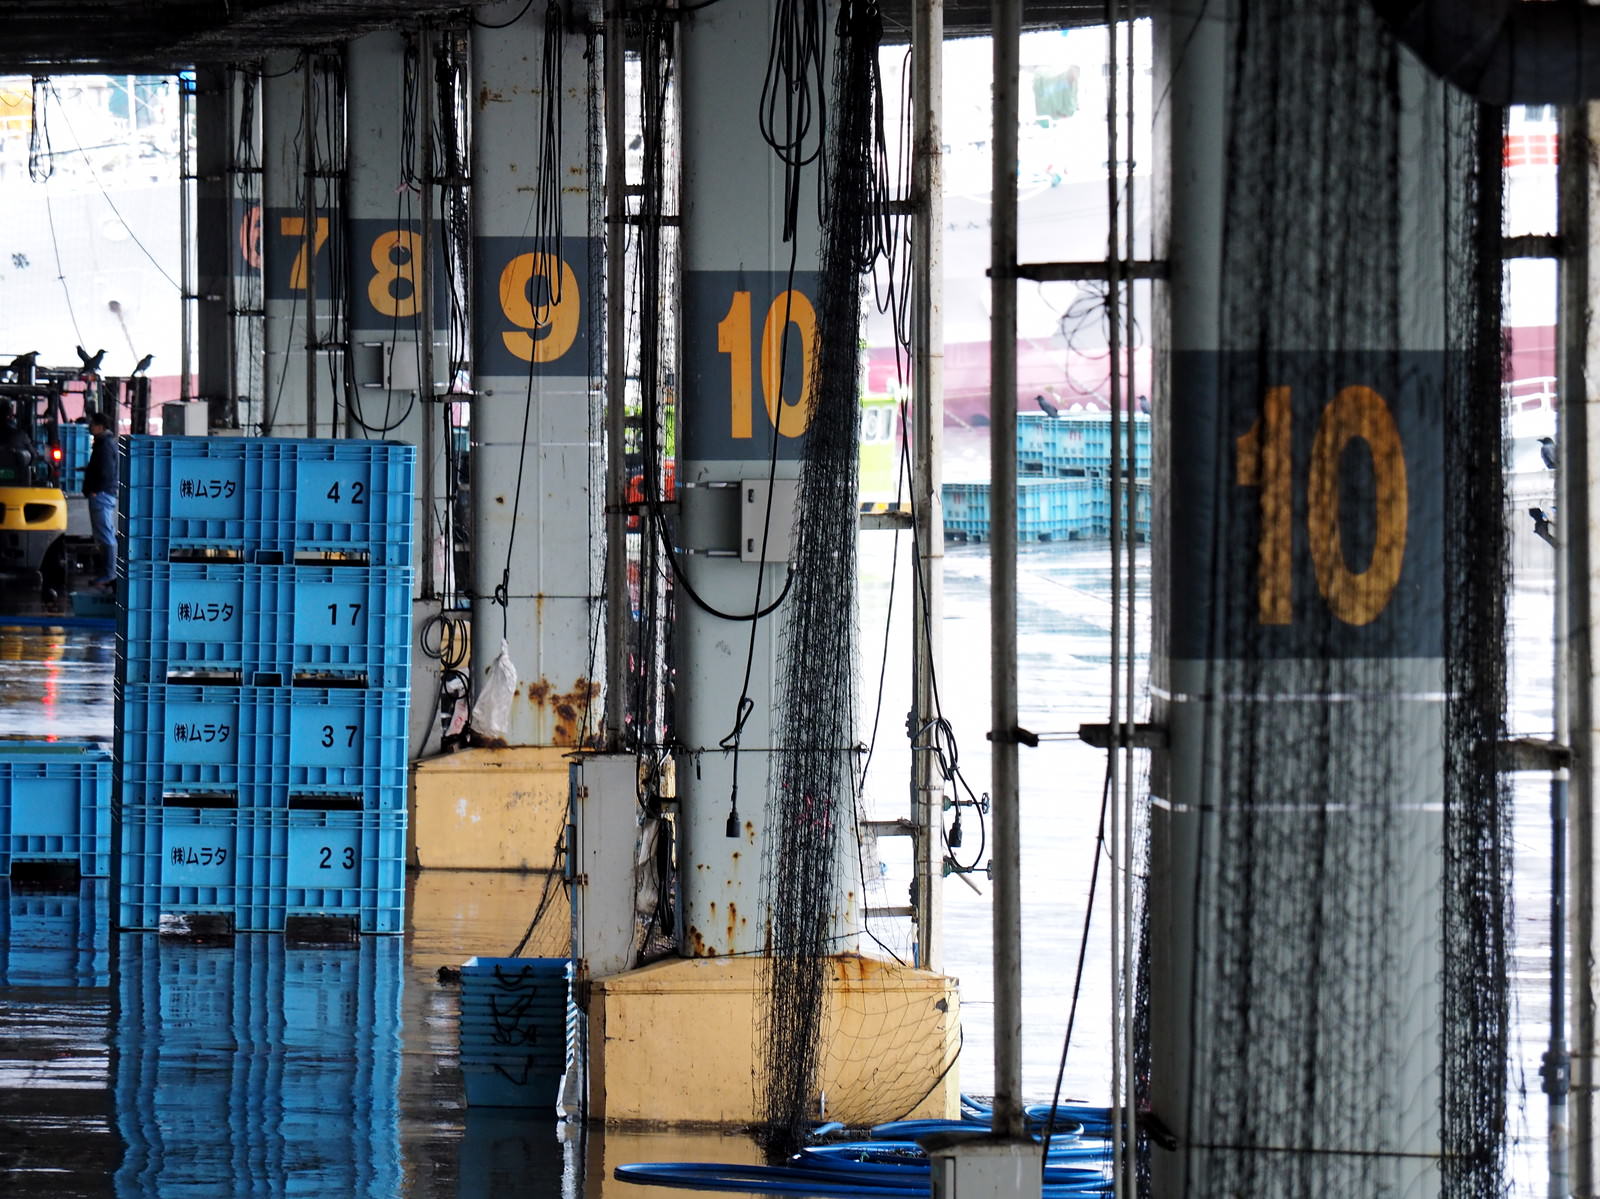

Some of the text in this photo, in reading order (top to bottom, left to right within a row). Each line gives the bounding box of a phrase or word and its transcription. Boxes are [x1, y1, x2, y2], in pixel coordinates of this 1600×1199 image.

[280, 216, 329, 290] 7
[367, 230, 424, 317] 8
[499, 251, 581, 363] 9
[717, 289, 823, 439] 10
[327, 480, 364, 504] 42
[1235, 384, 1409, 627] 10
[327, 603, 362, 626] 17
[321, 724, 358, 748] 37
[319, 846, 355, 870] 23
